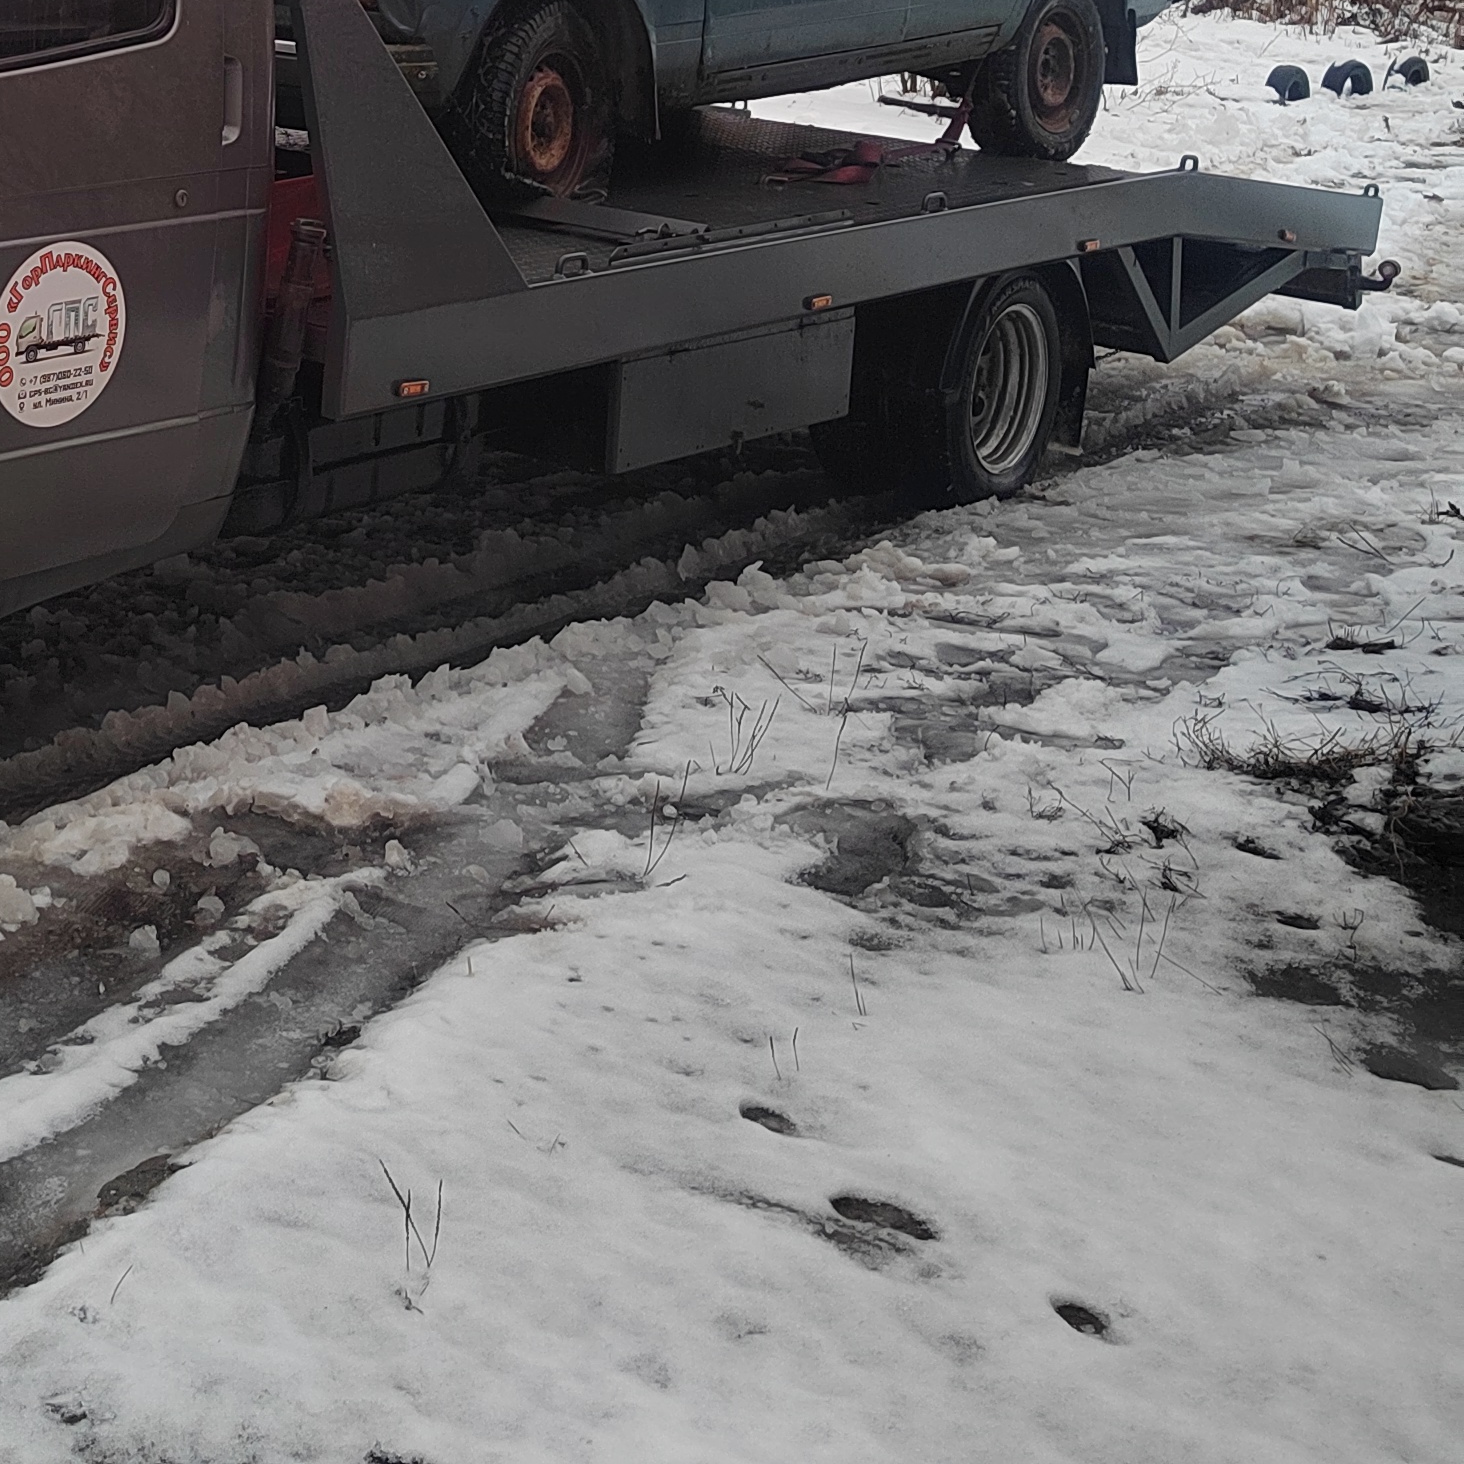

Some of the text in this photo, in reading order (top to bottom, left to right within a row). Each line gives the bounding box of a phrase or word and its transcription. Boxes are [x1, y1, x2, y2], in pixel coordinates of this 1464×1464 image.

[47, 296, 99, 342] ГПС
[29, 376, 38, 386] +7
[76, 390, 88, 401] 2/1
